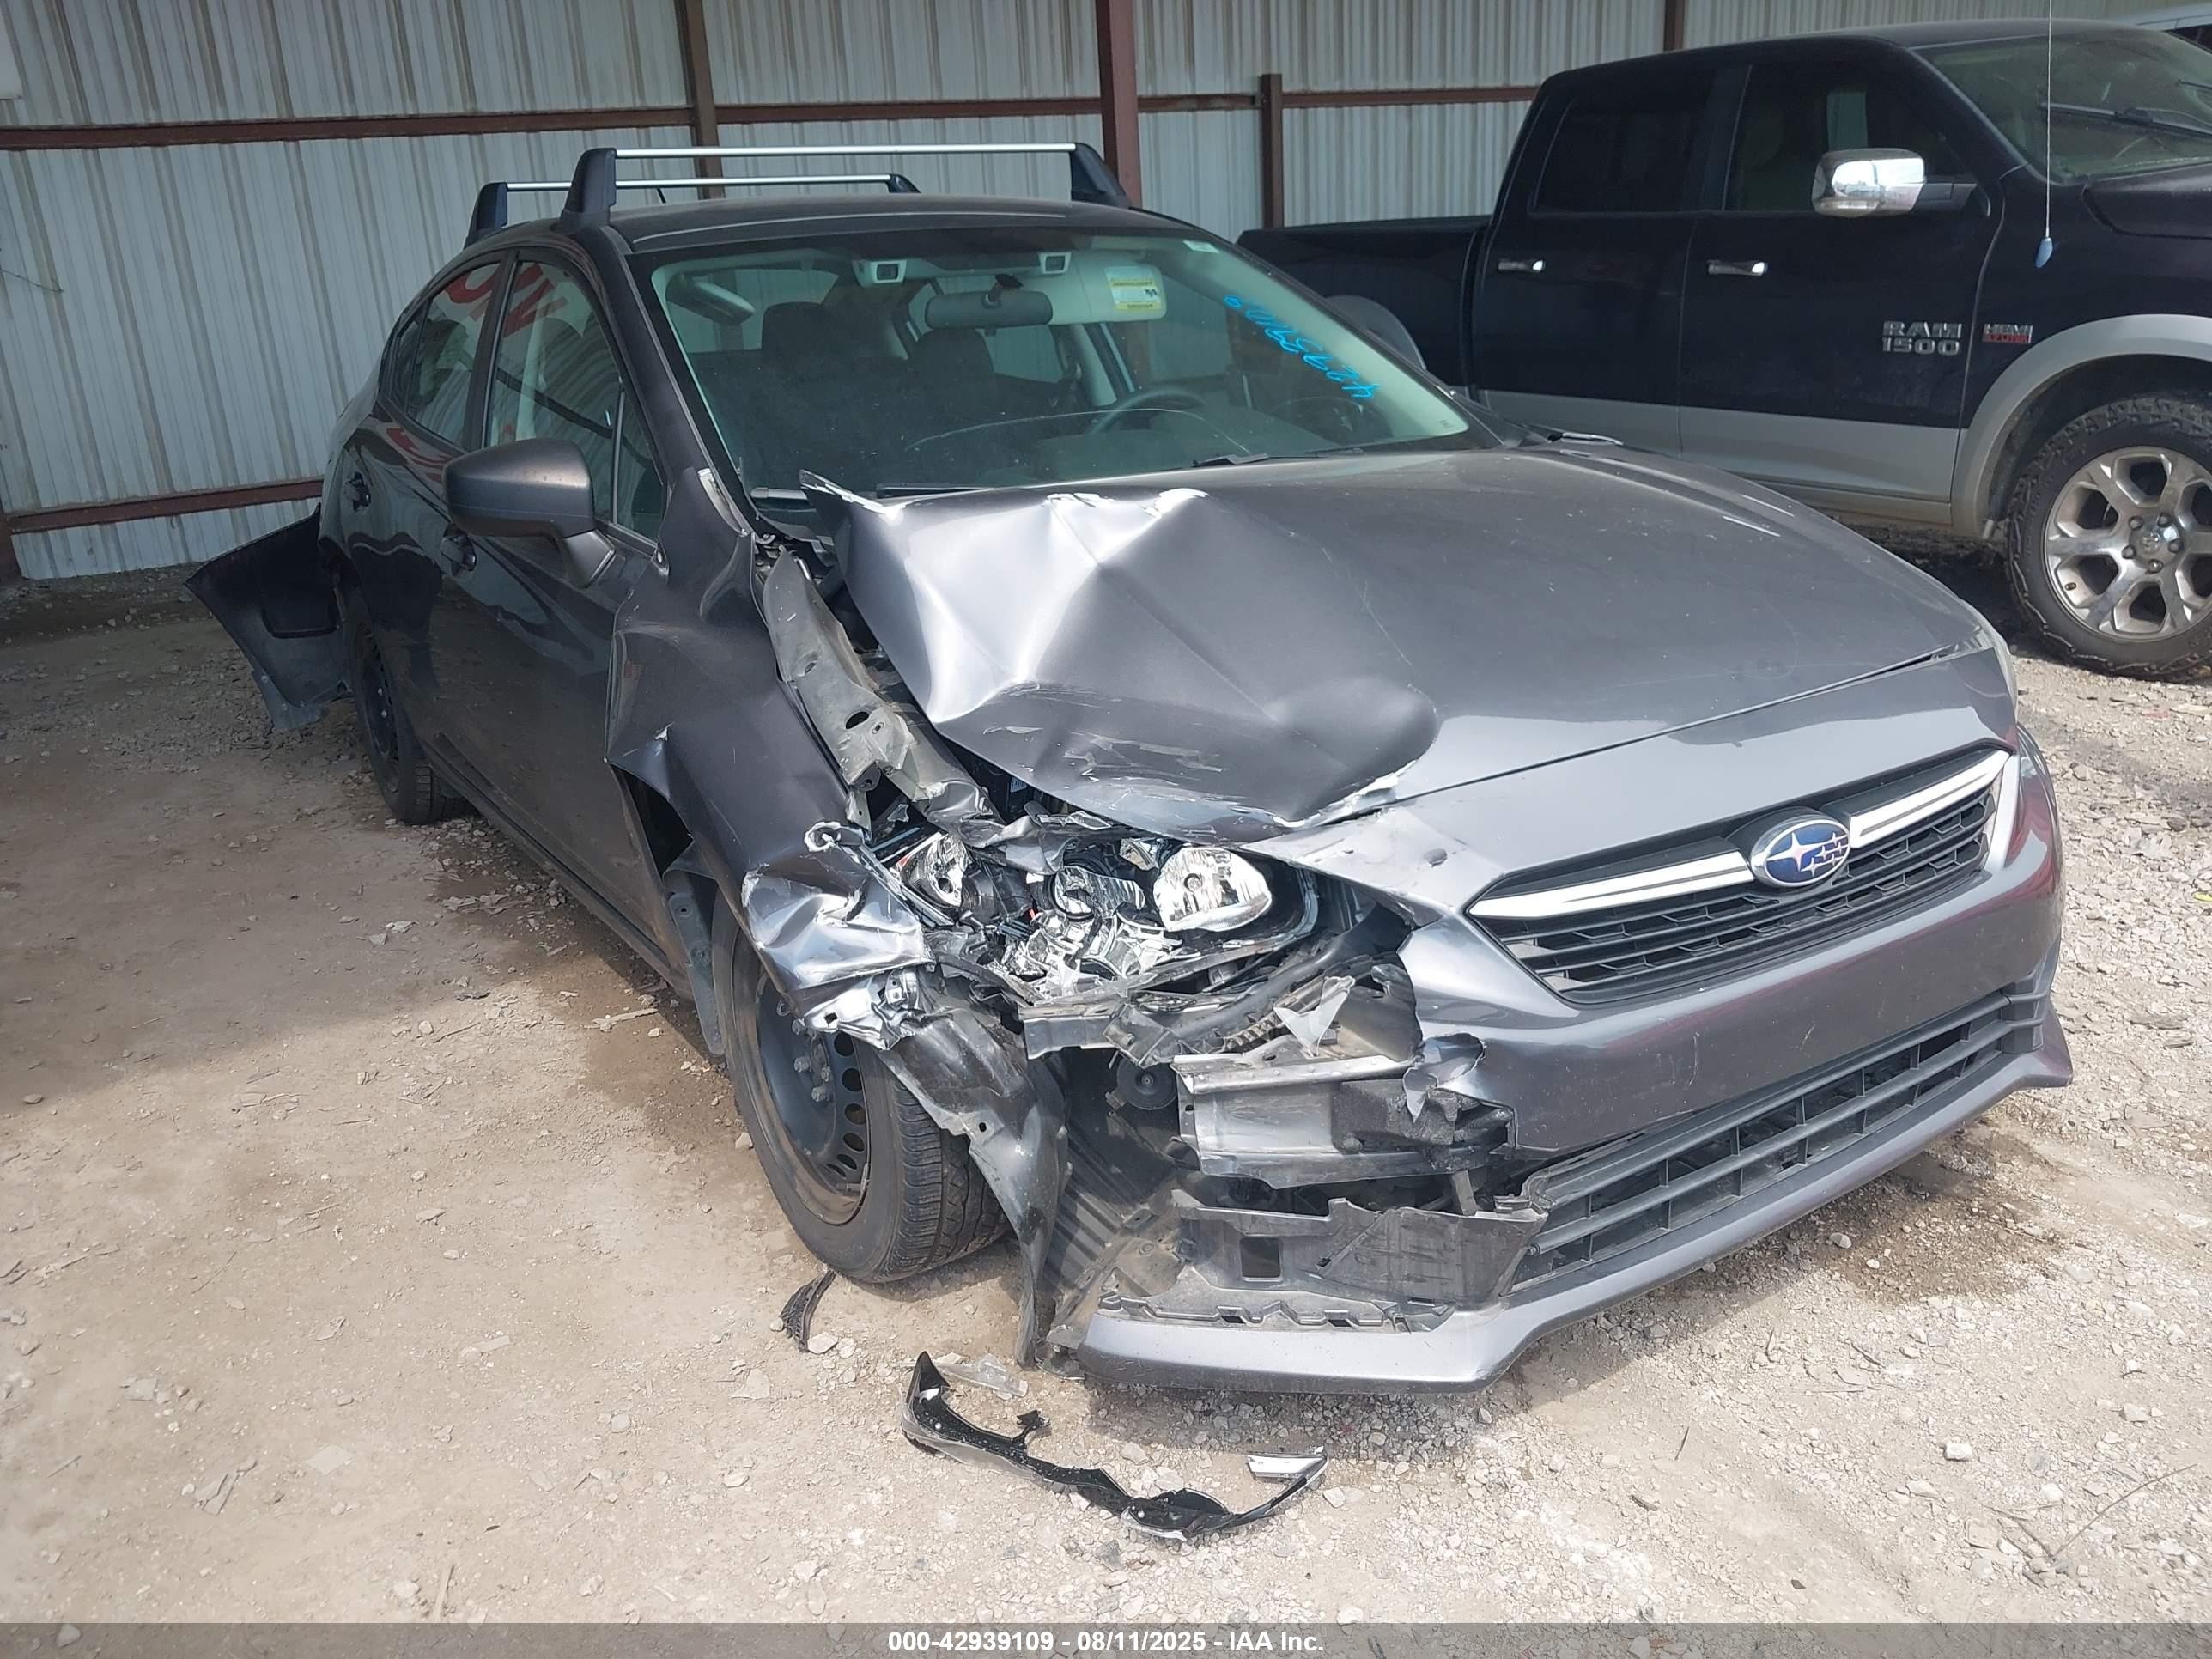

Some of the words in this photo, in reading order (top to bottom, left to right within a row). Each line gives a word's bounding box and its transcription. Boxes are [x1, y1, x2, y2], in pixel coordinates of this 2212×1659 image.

[1882, 320, 1962, 338] RAM
[1984, 323, 2033, 336] HEMI
[1881, 337, 1960, 356] 1500
